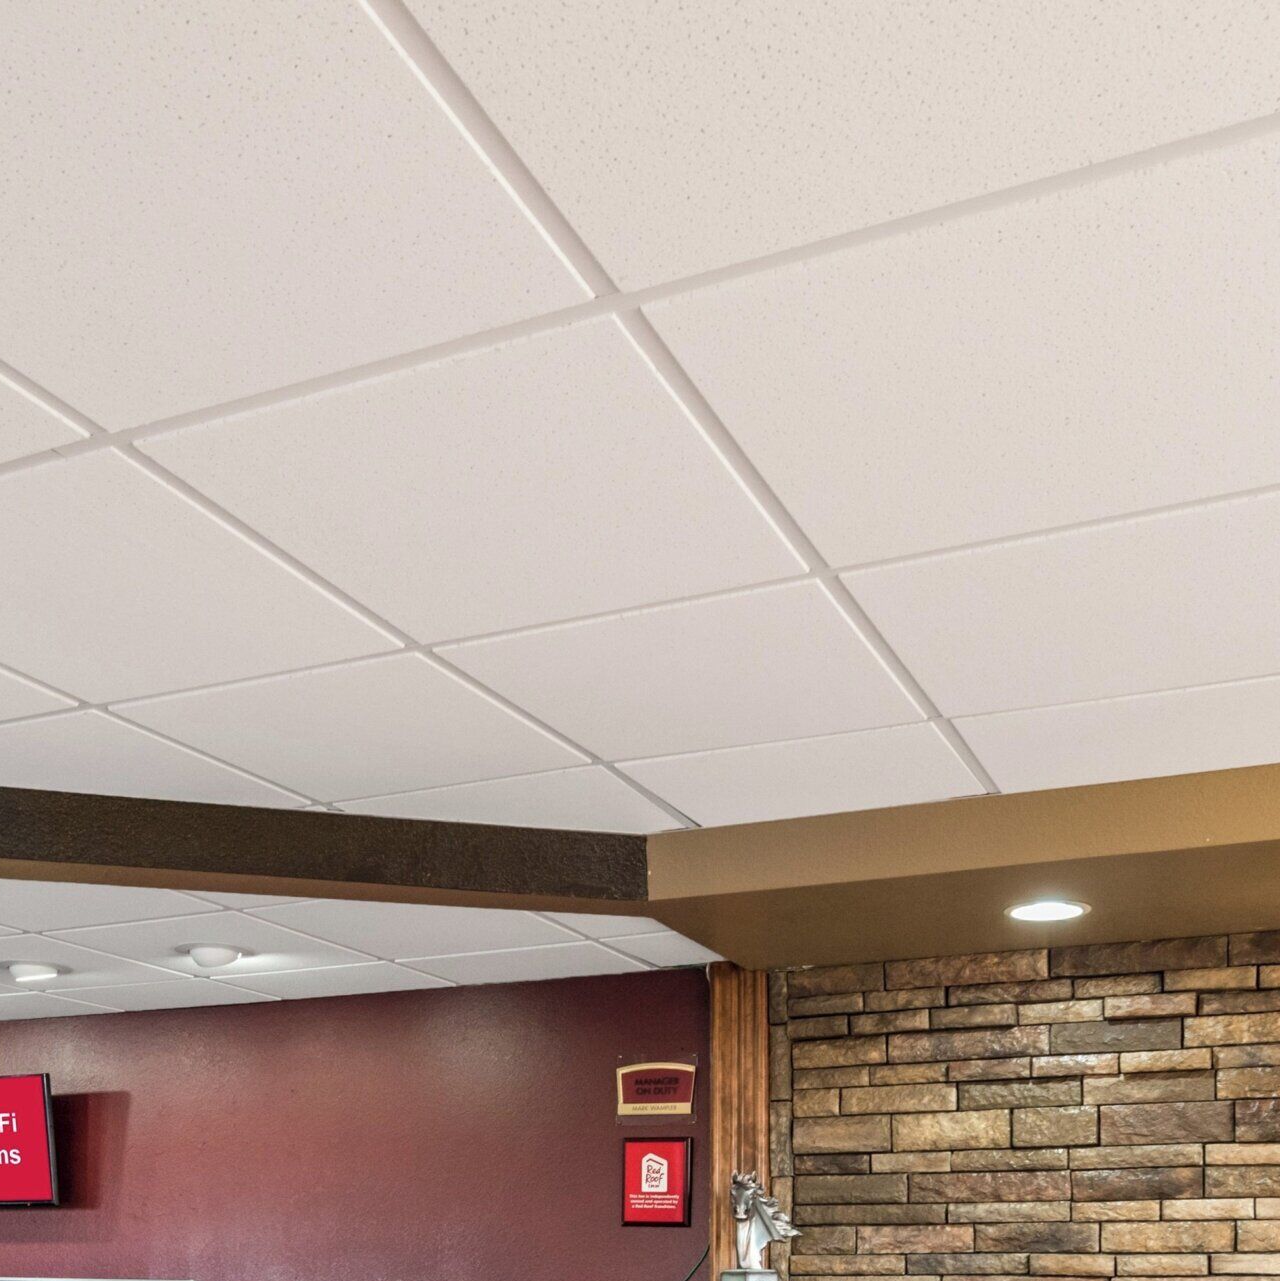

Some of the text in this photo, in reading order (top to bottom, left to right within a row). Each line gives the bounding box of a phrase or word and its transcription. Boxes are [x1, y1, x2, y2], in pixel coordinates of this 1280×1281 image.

[636, 1086, 678, 1096] ON DUTY
[646, 1164, 662, 1175] Red
[645, 1172, 665, 1184] Roof
